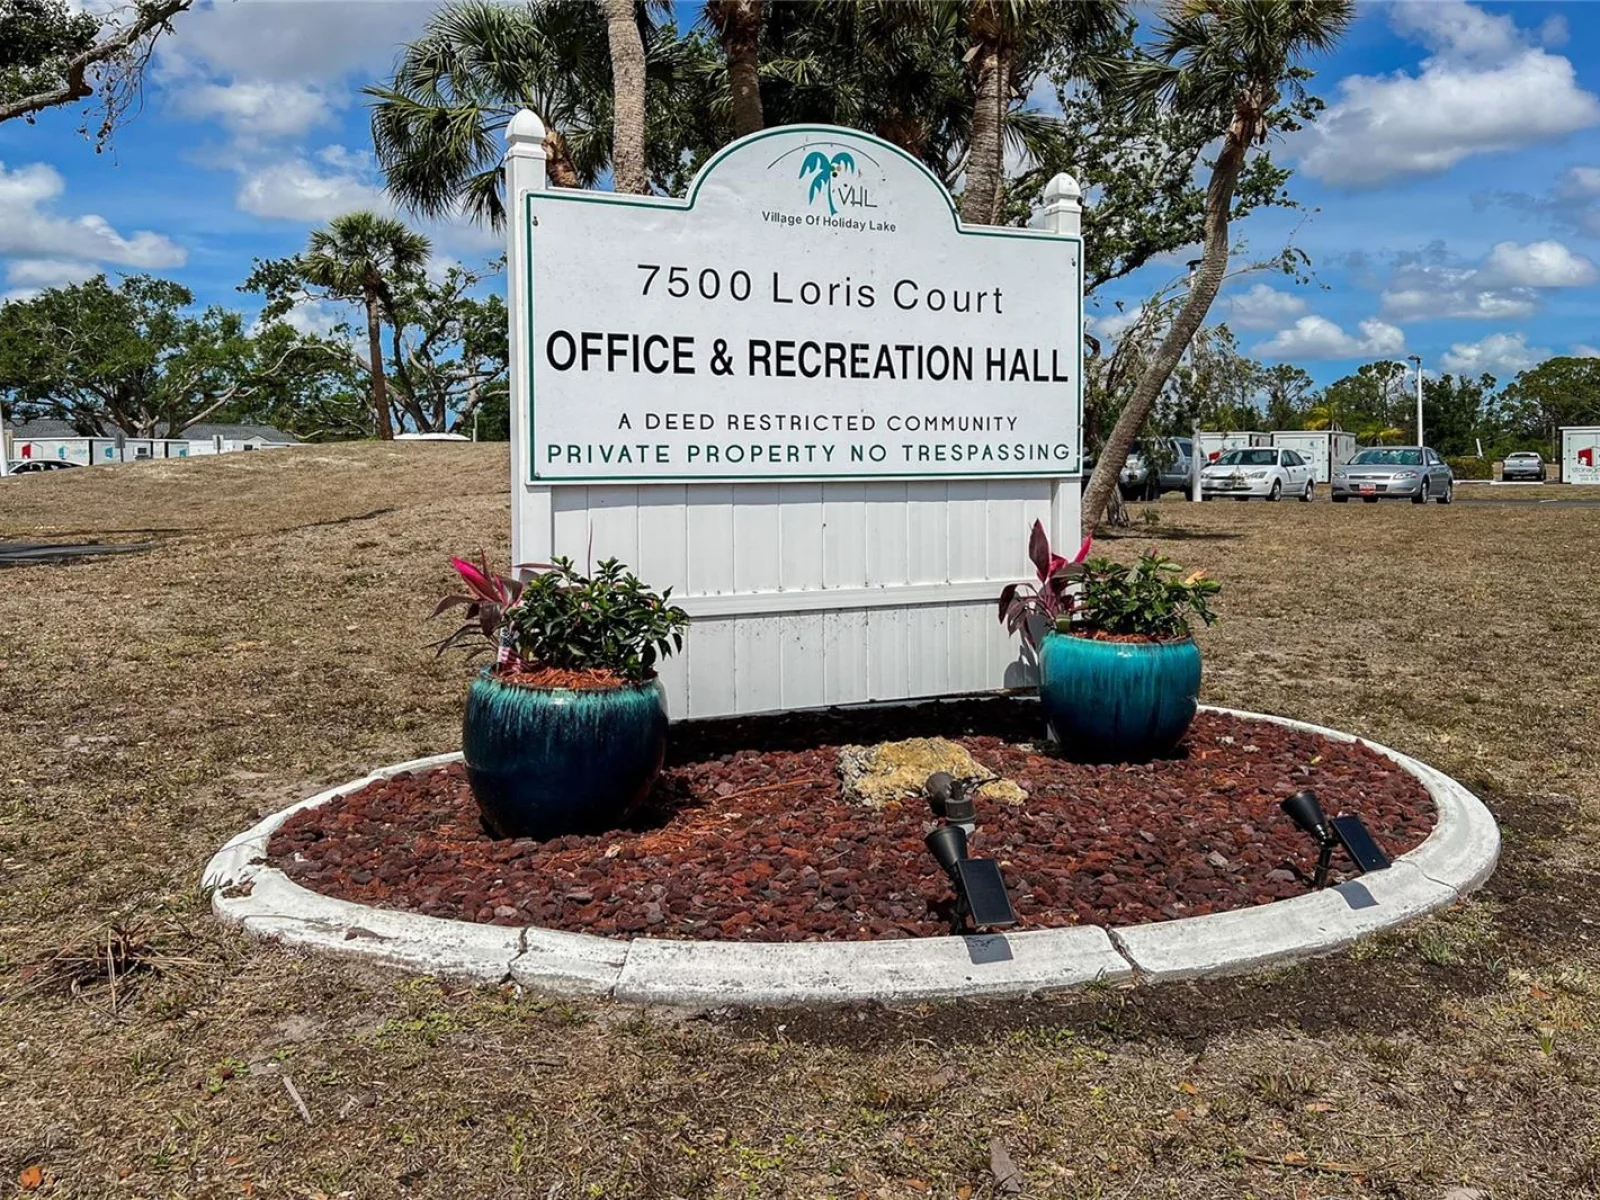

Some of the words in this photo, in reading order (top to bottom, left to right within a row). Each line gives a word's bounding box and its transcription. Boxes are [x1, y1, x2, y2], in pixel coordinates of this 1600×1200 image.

[838, 186, 877, 207] VHL
[762, 211, 802, 226] Village
[805, 215, 820, 226] Of
[822, 216, 866, 232] Holiday
[869, 220, 896, 232] Lake
[636, 264, 752, 302] 7500
[773, 272, 876, 309] Loris
[894, 280, 1003, 314] Court
[546, 330, 696, 375] OFFICE
[710, 338, 735, 377] &
[748, 339, 973, 382] RECREATION
[985, 347, 1069, 383] HALL
[618, 413, 632, 430] A
[645, 413, 715, 431] DEED
[727, 414, 876, 431] RESTRICTED
[886, 416, 1018, 432] COMMUNITY
[547, 444, 670, 464] PRIVATE
[687, 444, 836, 464] PROPERTY
[850, 444, 887, 463] NO
[901, 443, 1070, 462] TRESPASSING
